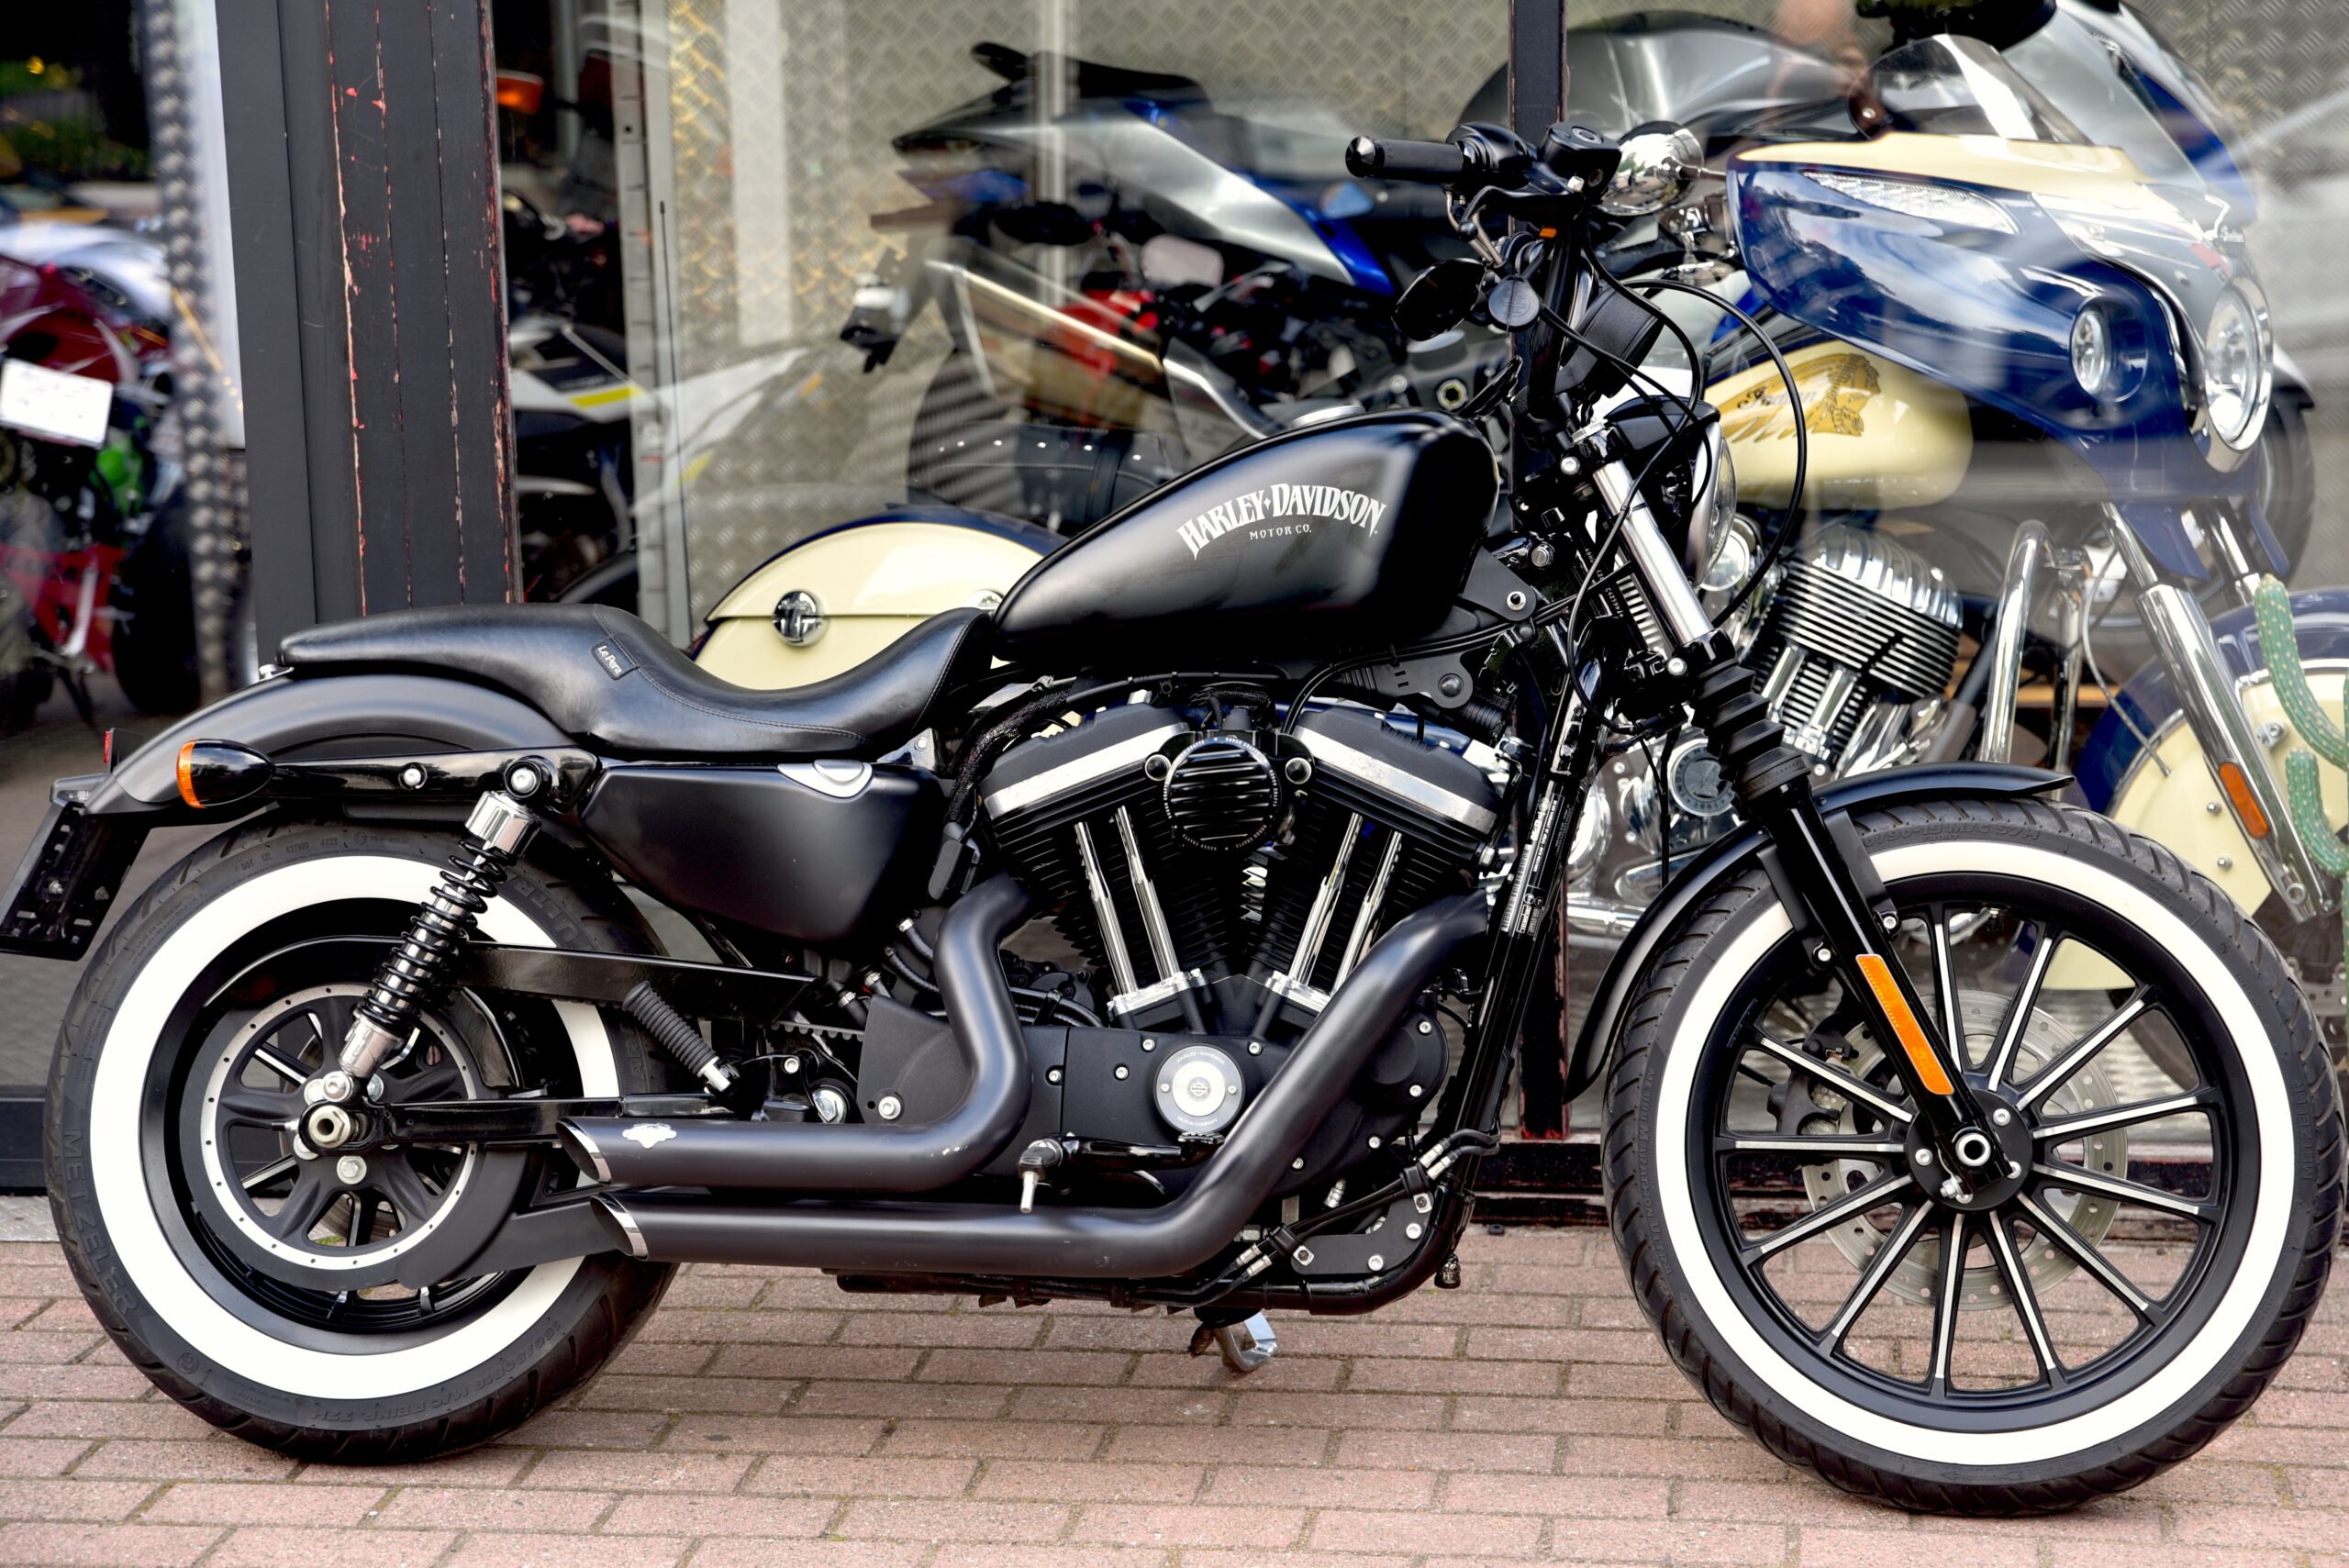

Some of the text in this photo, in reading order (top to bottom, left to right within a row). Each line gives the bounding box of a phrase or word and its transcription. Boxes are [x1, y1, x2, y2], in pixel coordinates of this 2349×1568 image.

[1250, 524, 1312, 540] MOTOR CO.
[597, 645, 622, 674] Le Pera
[513, 880, 580, 944] ULTR
[62, 1129, 138, 1316] METZELER
[1650, 1222, 1672, 1275] ULTRA
